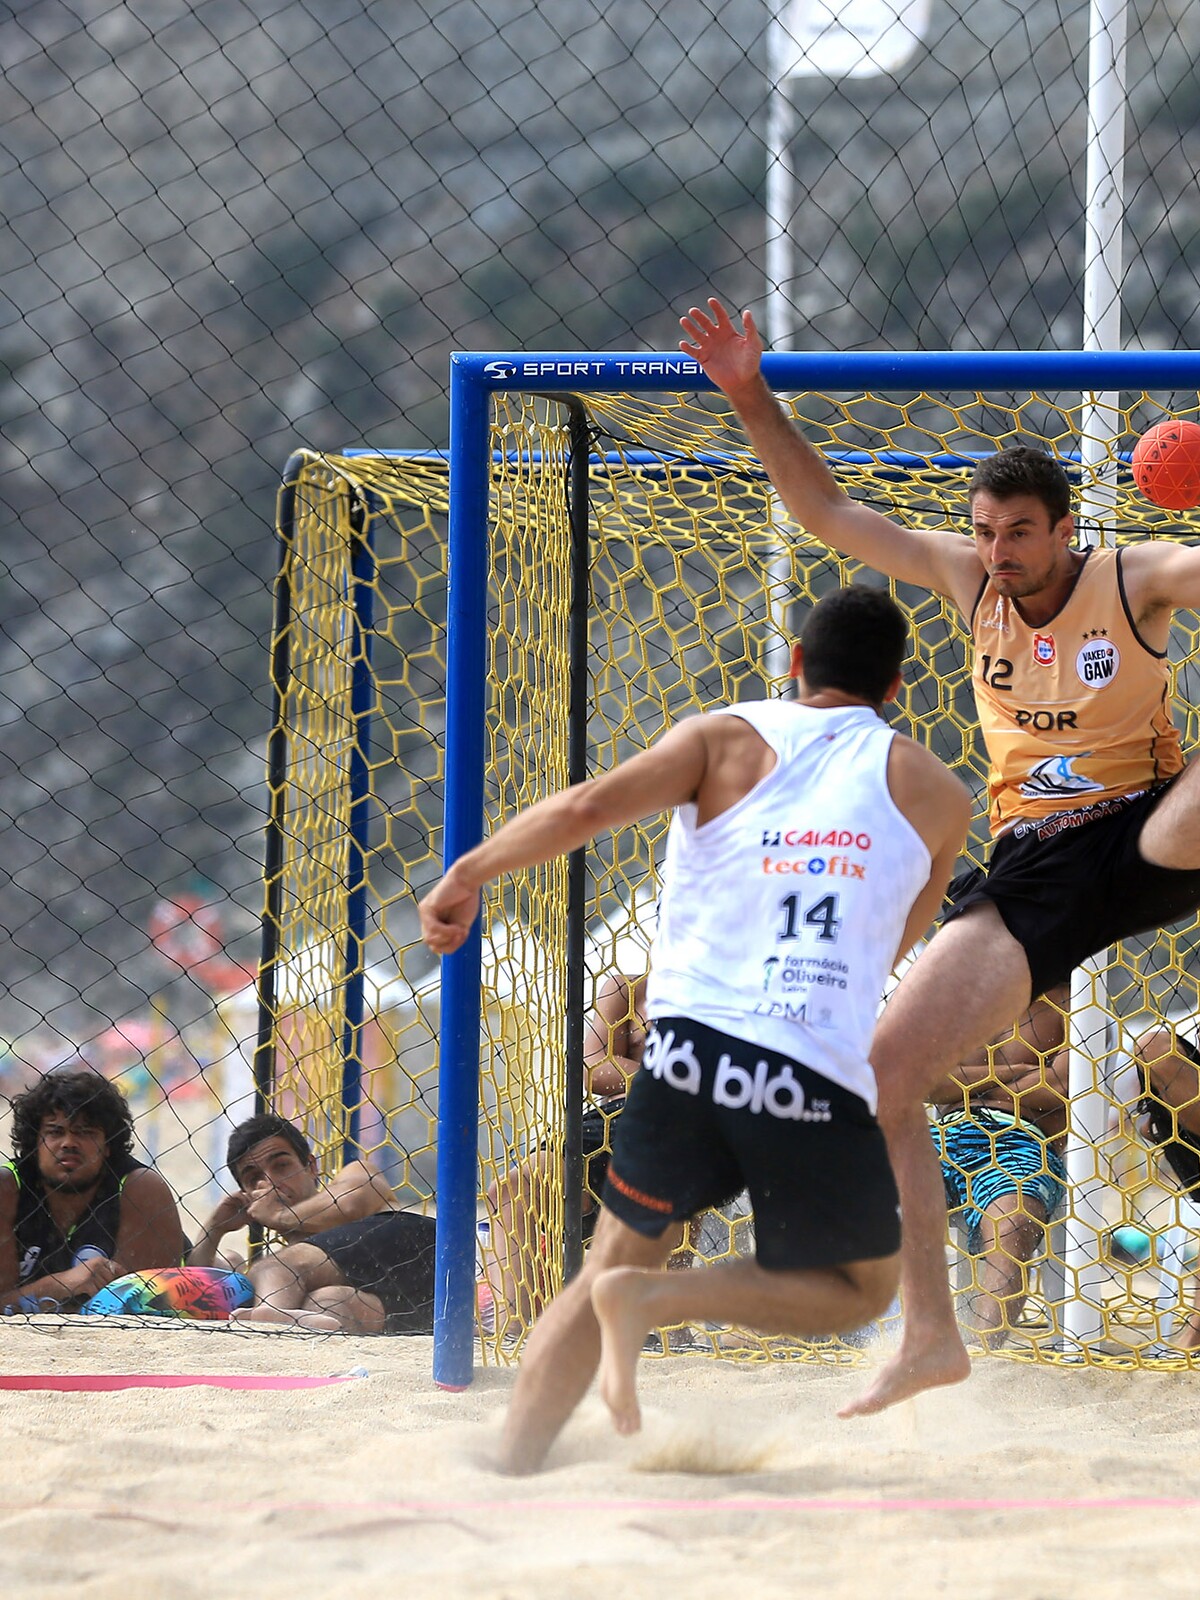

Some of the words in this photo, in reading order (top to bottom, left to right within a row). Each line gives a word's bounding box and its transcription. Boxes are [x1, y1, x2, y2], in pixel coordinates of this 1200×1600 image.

[523, 361, 606, 376] SPORT
[616, 361, 704, 376] TRANS
[981, 655, 1014, 691] 12
[1084, 659, 1113, 681] GAW
[1015, 710, 1079, 732] POR
[785, 830, 872, 851] CAIADO
[777, 892, 841, 943] 14
[782, 969, 848, 990] Oliveira
